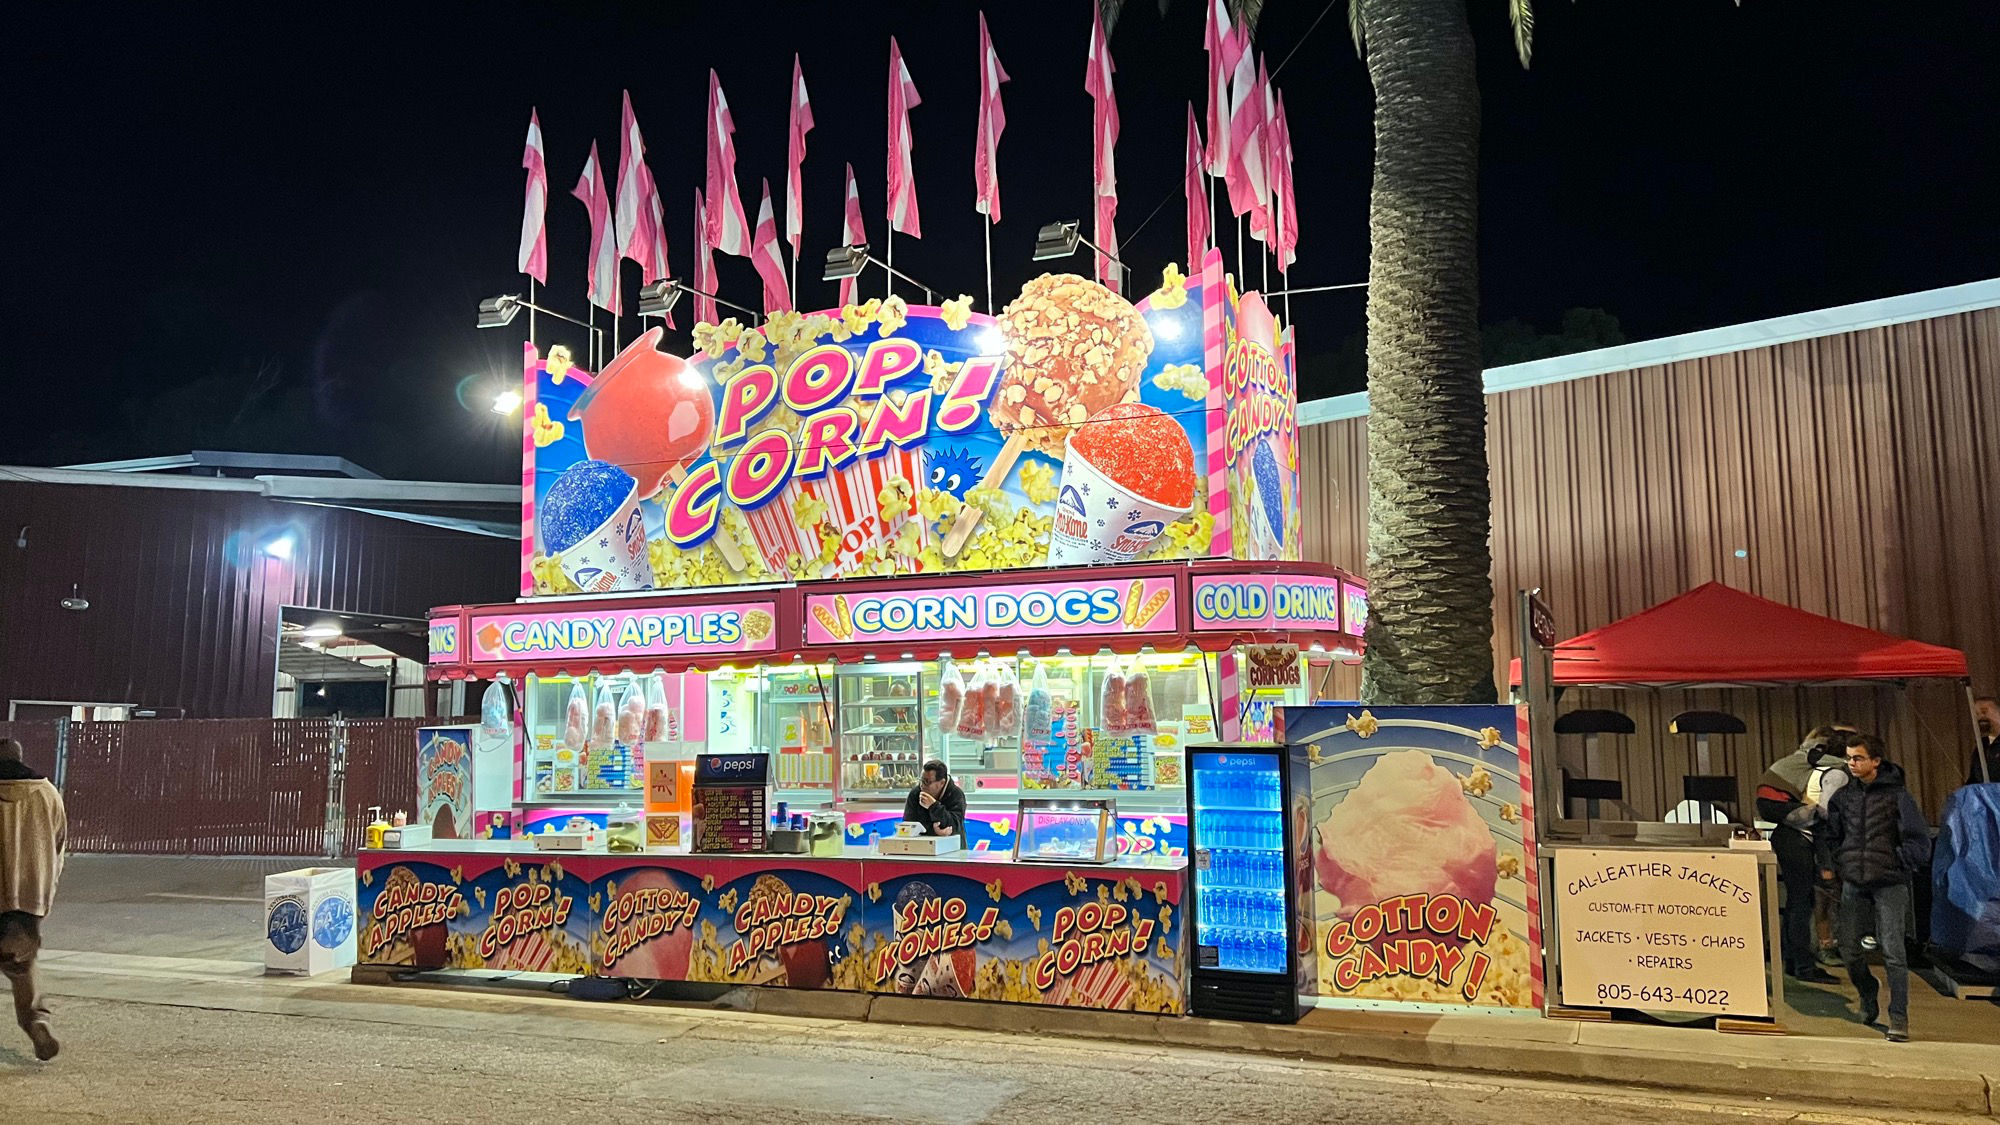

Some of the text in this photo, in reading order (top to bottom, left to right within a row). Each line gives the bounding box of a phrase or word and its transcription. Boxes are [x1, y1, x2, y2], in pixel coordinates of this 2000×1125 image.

[1224, 337, 1288, 400] COTTON
[714, 337, 923, 447] POP
[1225, 391, 1296, 466] CANDY!
[665, 355, 1004, 547] CORN!
[853, 588, 1120, 633] CORN DOGS
[1197, 584, 1335, 621] COLD DRINKS
[503, 612, 742, 652] CANDY APPLES
[1251, 665, 1300, 686] CORN DOGS
[428, 740, 461, 780] CANDY
[724, 758, 755, 772] pepsi
[1229, 757, 1256, 767] pepsi
[1038, 816, 1089, 825] DISPLAY ONLY
[373, 882, 457, 919] CANDY
[494, 883, 551, 919] POP
[1568, 862, 1753, 904] CAL-LEATHER JACKETS
[368, 893, 463, 955] APPLES!
[480, 897, 572, 957] CORN!
[603, 889, 689, 933] COTTON
[735, 892, 839, 933] CANDY
[901, 897, 967, 933] SNO
[1052, 902, 1127, 943] POP
[1328, 894, 1497, 955] COTTON
[1588, 902, 1728, 917] CUSTOM-FIT MOTORCYCLE
[603, 898, 700, 966] CANDY!
[728, 905, 845, 975] APPLES!
[875, 907, 999, 984] KONES!
[1576, 930, 1745, 949] JACKETS VESTS CHAPS
[1035, 919, 1155, 989] CORN!
[1637, 956, 1693, 970] REPAIRS
[1598, 984, 1729, 1006] 805-643-4022
